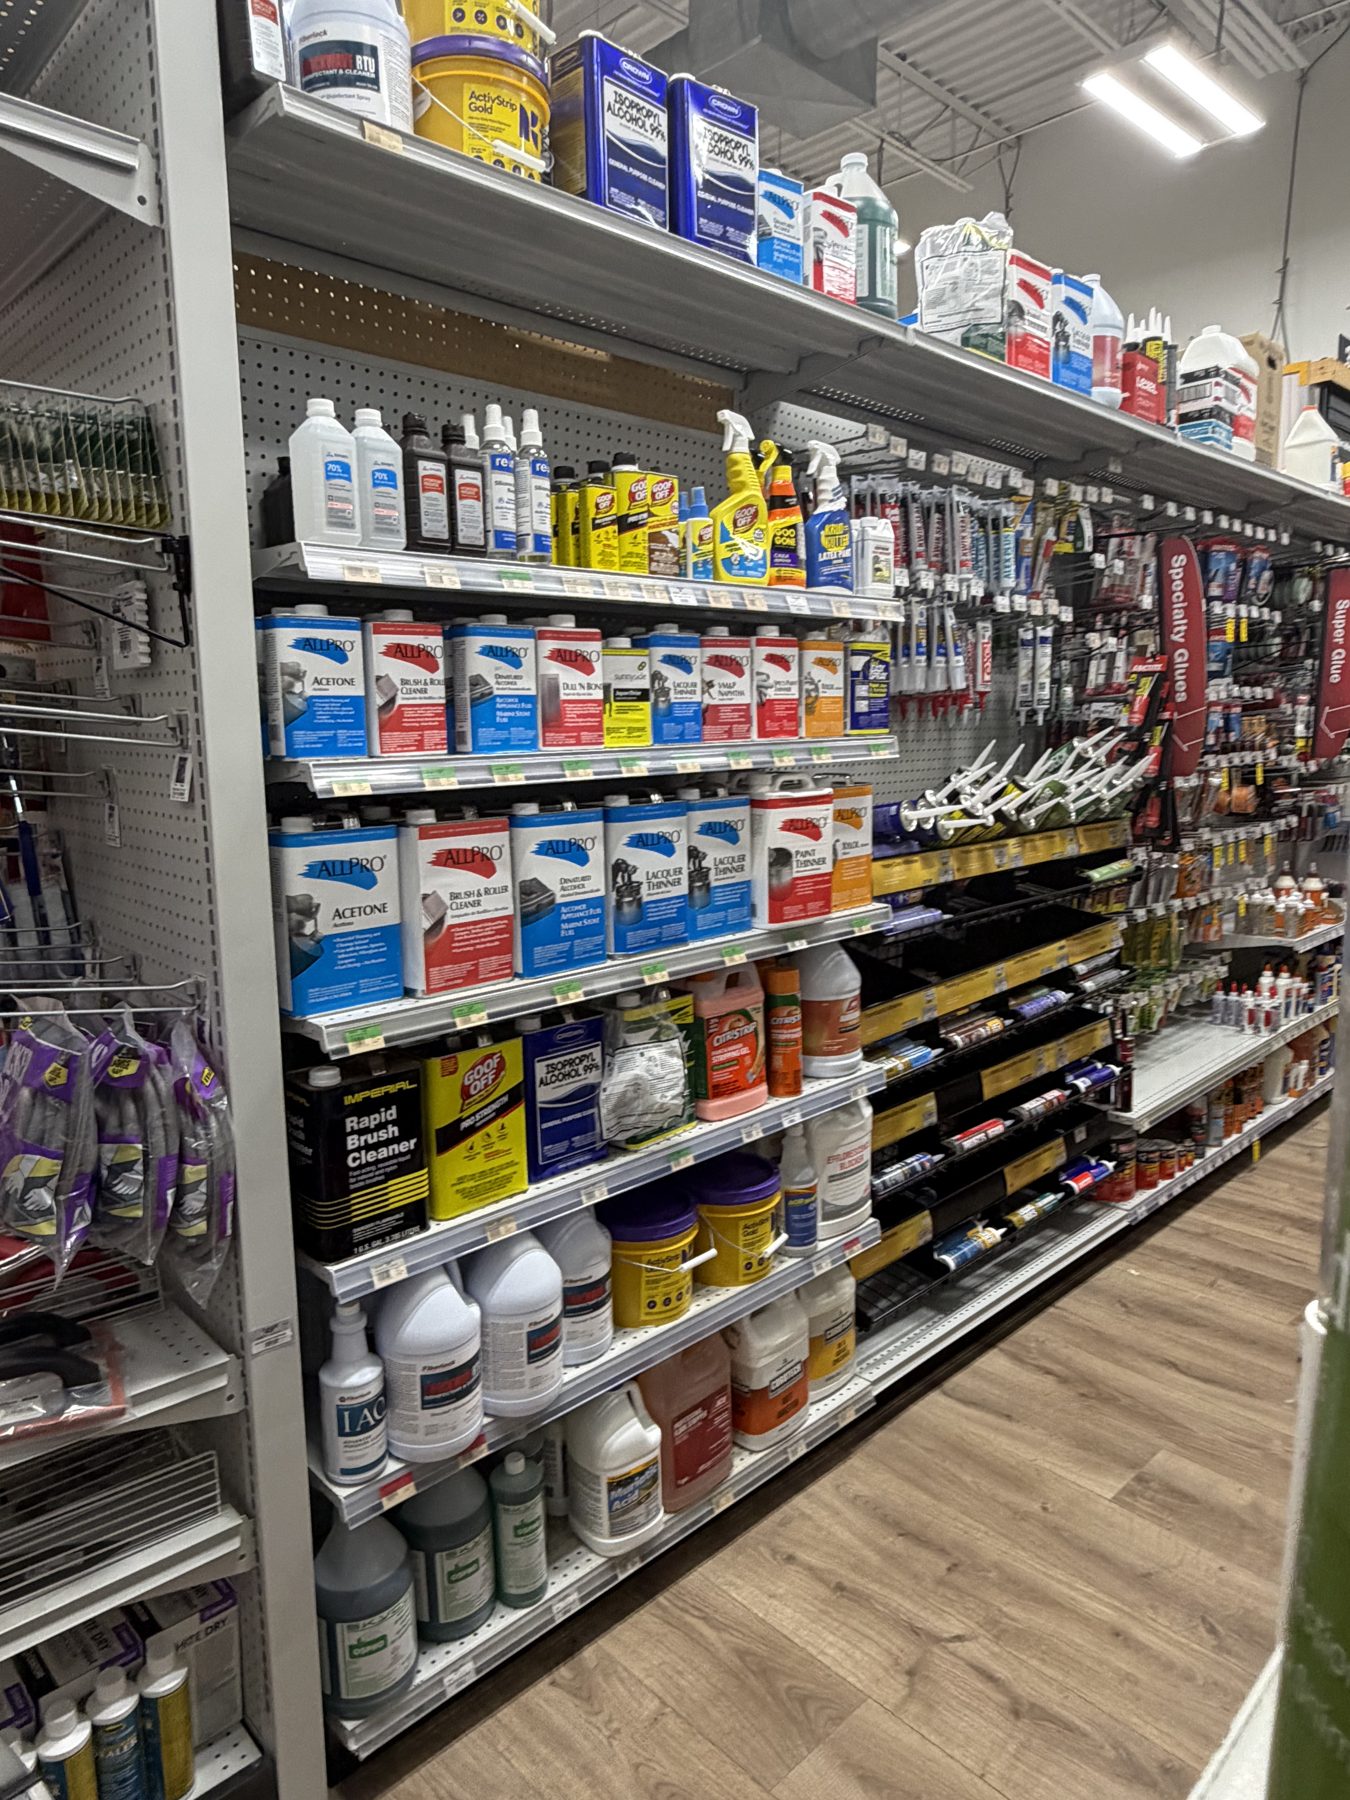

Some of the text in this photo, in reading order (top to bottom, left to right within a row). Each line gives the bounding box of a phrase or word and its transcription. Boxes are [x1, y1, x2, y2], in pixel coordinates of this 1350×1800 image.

[355, 54, 376, 73] RTU
[468, 90, 518, 112] ActivStrip
[468, 101, 493, 115] Gold
[612, 90, 663, 127] ISOPROPYL
[606, 102, 649, 133] ALCOHOL
[703, 126, 751, 157] ISOPROPYL
[327, 463, 343, 473] 70%
[374, 471, 389, 481] 70%
[655, 490, 670, 500] OFF
[736, 516, 753, 528] OFF
[774, 528, 796, 538] GOO
[1168, 553, 1191, 703] Specialty Glues
[302, 638, 355, 653] ALLPRO
[1329, 599, 1350, 684] Super Glue
[394, 643, 444, 659] ALLPRO
[487, 645, 528, 659] ALLPRO
[555, 650, 601, 664] ALLPRO
[312, 676, 356, 687] ACETONE
[400, 677, 422, 687] BRUSH
[423, 678, 429, 687] &
[672, 681, 698, 689] LACQUER
[400, 686, 429, 696] CLEANER
[707, 818, 745, 834] ALLPRO
[545, 837, 596, 856] ALLPRO
[635, 830, 681, 848] ALLPRO
[445, 845, 504, 866] ALLPRO
[713, 854, 747, 867] LACQUER
[794, 849, 817, 858] PAINT
[316, 856, 385, 878] ALLPRO
[795, 857, 827, 867] THINNER
[645, 867, 684, 881] LACQUER
[714, 864, 746, 877] THINNER
[559, 874, 592, 886] DENATURED
[645, 877, 683, 892] THINNER
[448, 885, 510, 901] BRUSH & ROLLER
[559, 884, 586, 893] ALCOHOL
[332, 902, 389, 921] ACETONE
[449, 899, 482, 911] CLEANER
[463, 1052, 502, 1086] GOOF
[545, 1052, 597, 1075] ISOPROPYL
[469, 1069, 497, 1096] OFF
[538, 1069, 581, 1088] ALCOHOL
[343, 1081, 418, 1106] IMPERIAL
[345, 1105, 398, 1133] Rapid
[346, 1124, 400, 1151] Brush
[346, 1138, 418, 1168] Cleaner
[421, 1361, 455, 1372] Fiberlock
[204, 1617, 229, 1636] DRY
